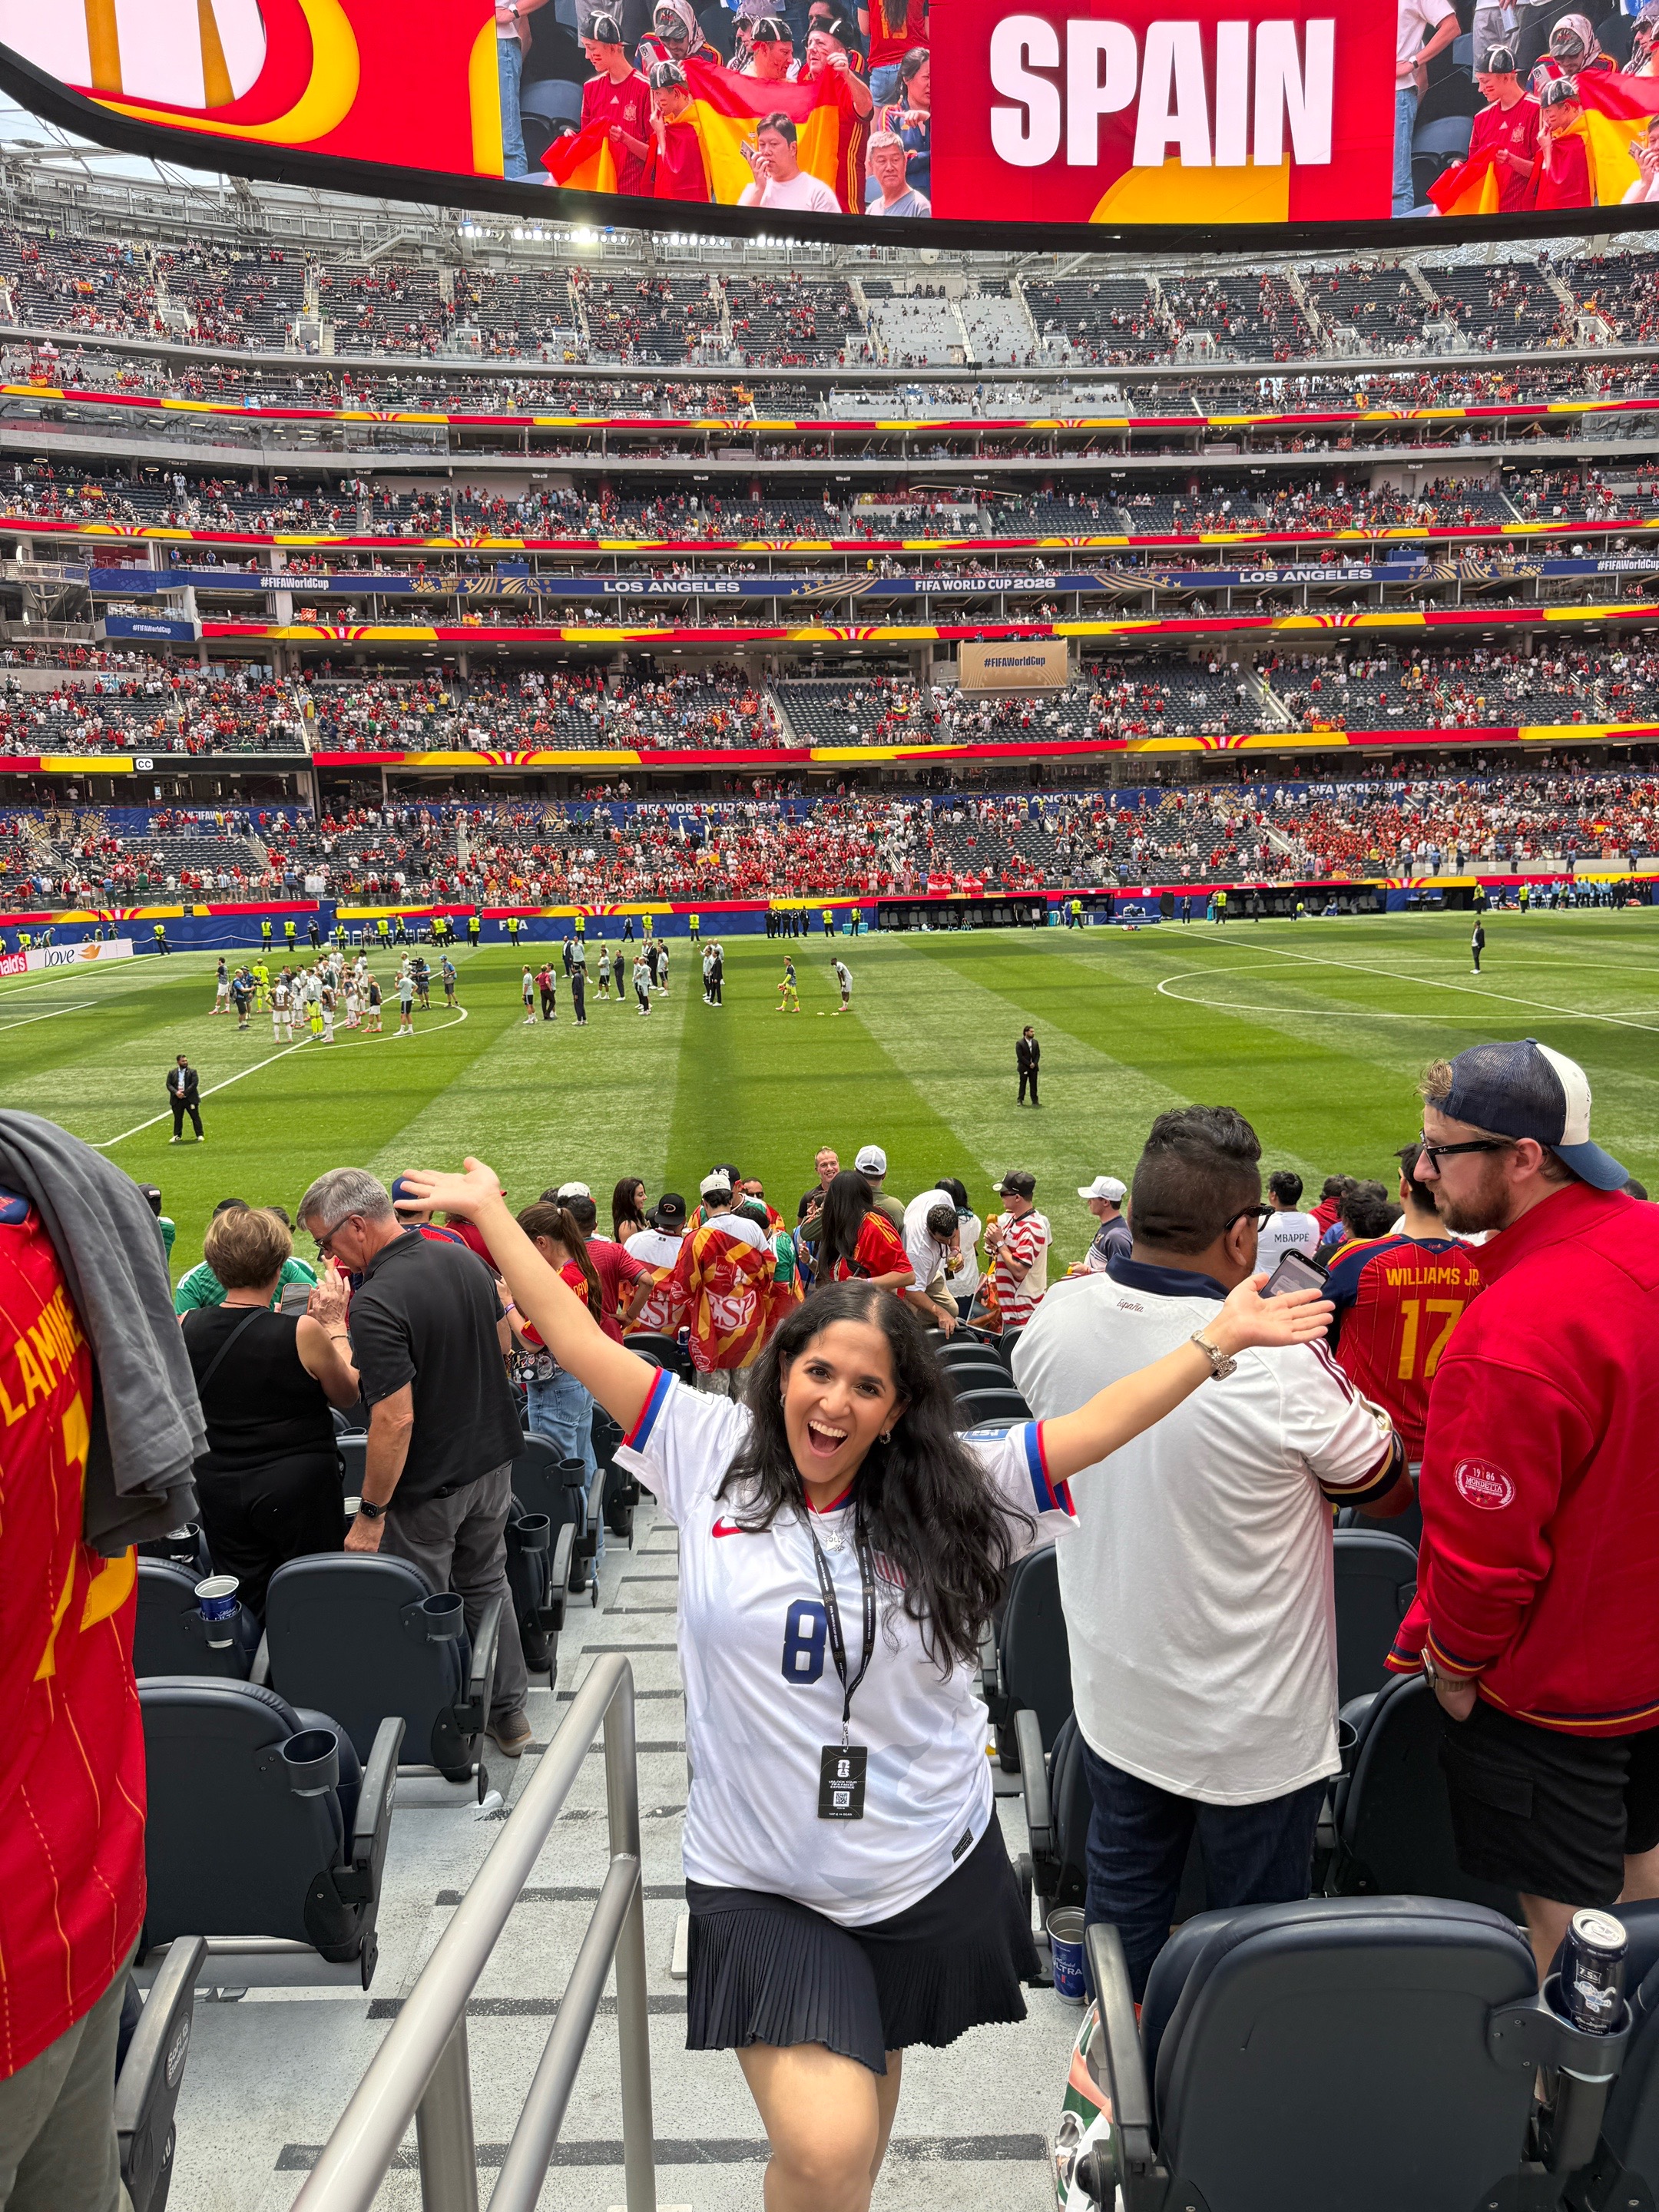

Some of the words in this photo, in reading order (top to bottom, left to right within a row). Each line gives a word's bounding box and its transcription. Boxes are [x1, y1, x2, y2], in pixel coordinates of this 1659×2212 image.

[990, 15, 1335, 167] SPAIN
[1597, 558, 1659, 571] #FIFAWorldCup
[1240, 571, 1278, 583] LOS
[1282, 569, 1373, 581] ANGELES
[260, 577, 329, 591] #FIFAWorldCup
[604, 581, 644, 592] LOS
[648, 582, 740, 592] ANGELES
[915, 581, 941, 591] FIFA
[942, 579, 986, 591] WORLD
[988, 579, 1012, 590] CUP
[1013, 578, 1056, 589] 2026
[132, 624, 171, 634] #FIFAWorldCup
[984, 656, 1045, 667] #FIFAWorldCup
[137, 760, 152, 768] CC
[44, 949, 75, 968] Dove
[1385, 1267, 1461, 1286] WILLIAMS
[1464, 1268, 1480, 1286] JR.
[1117, 1299, 1144, 1313] España
[1398, 1299, 1465, 1380] 17
[1472, 1468, 1481, 1478] 19
[1486, 1472, 1495, 1482] 86
[1465, 1476, 1503, 1493] MONDETTA
[782, 1599, 827, 1684] 8
[168, 2032, 182, 2068] SoFi
[168, 2036, 188, 2081] Stadium
